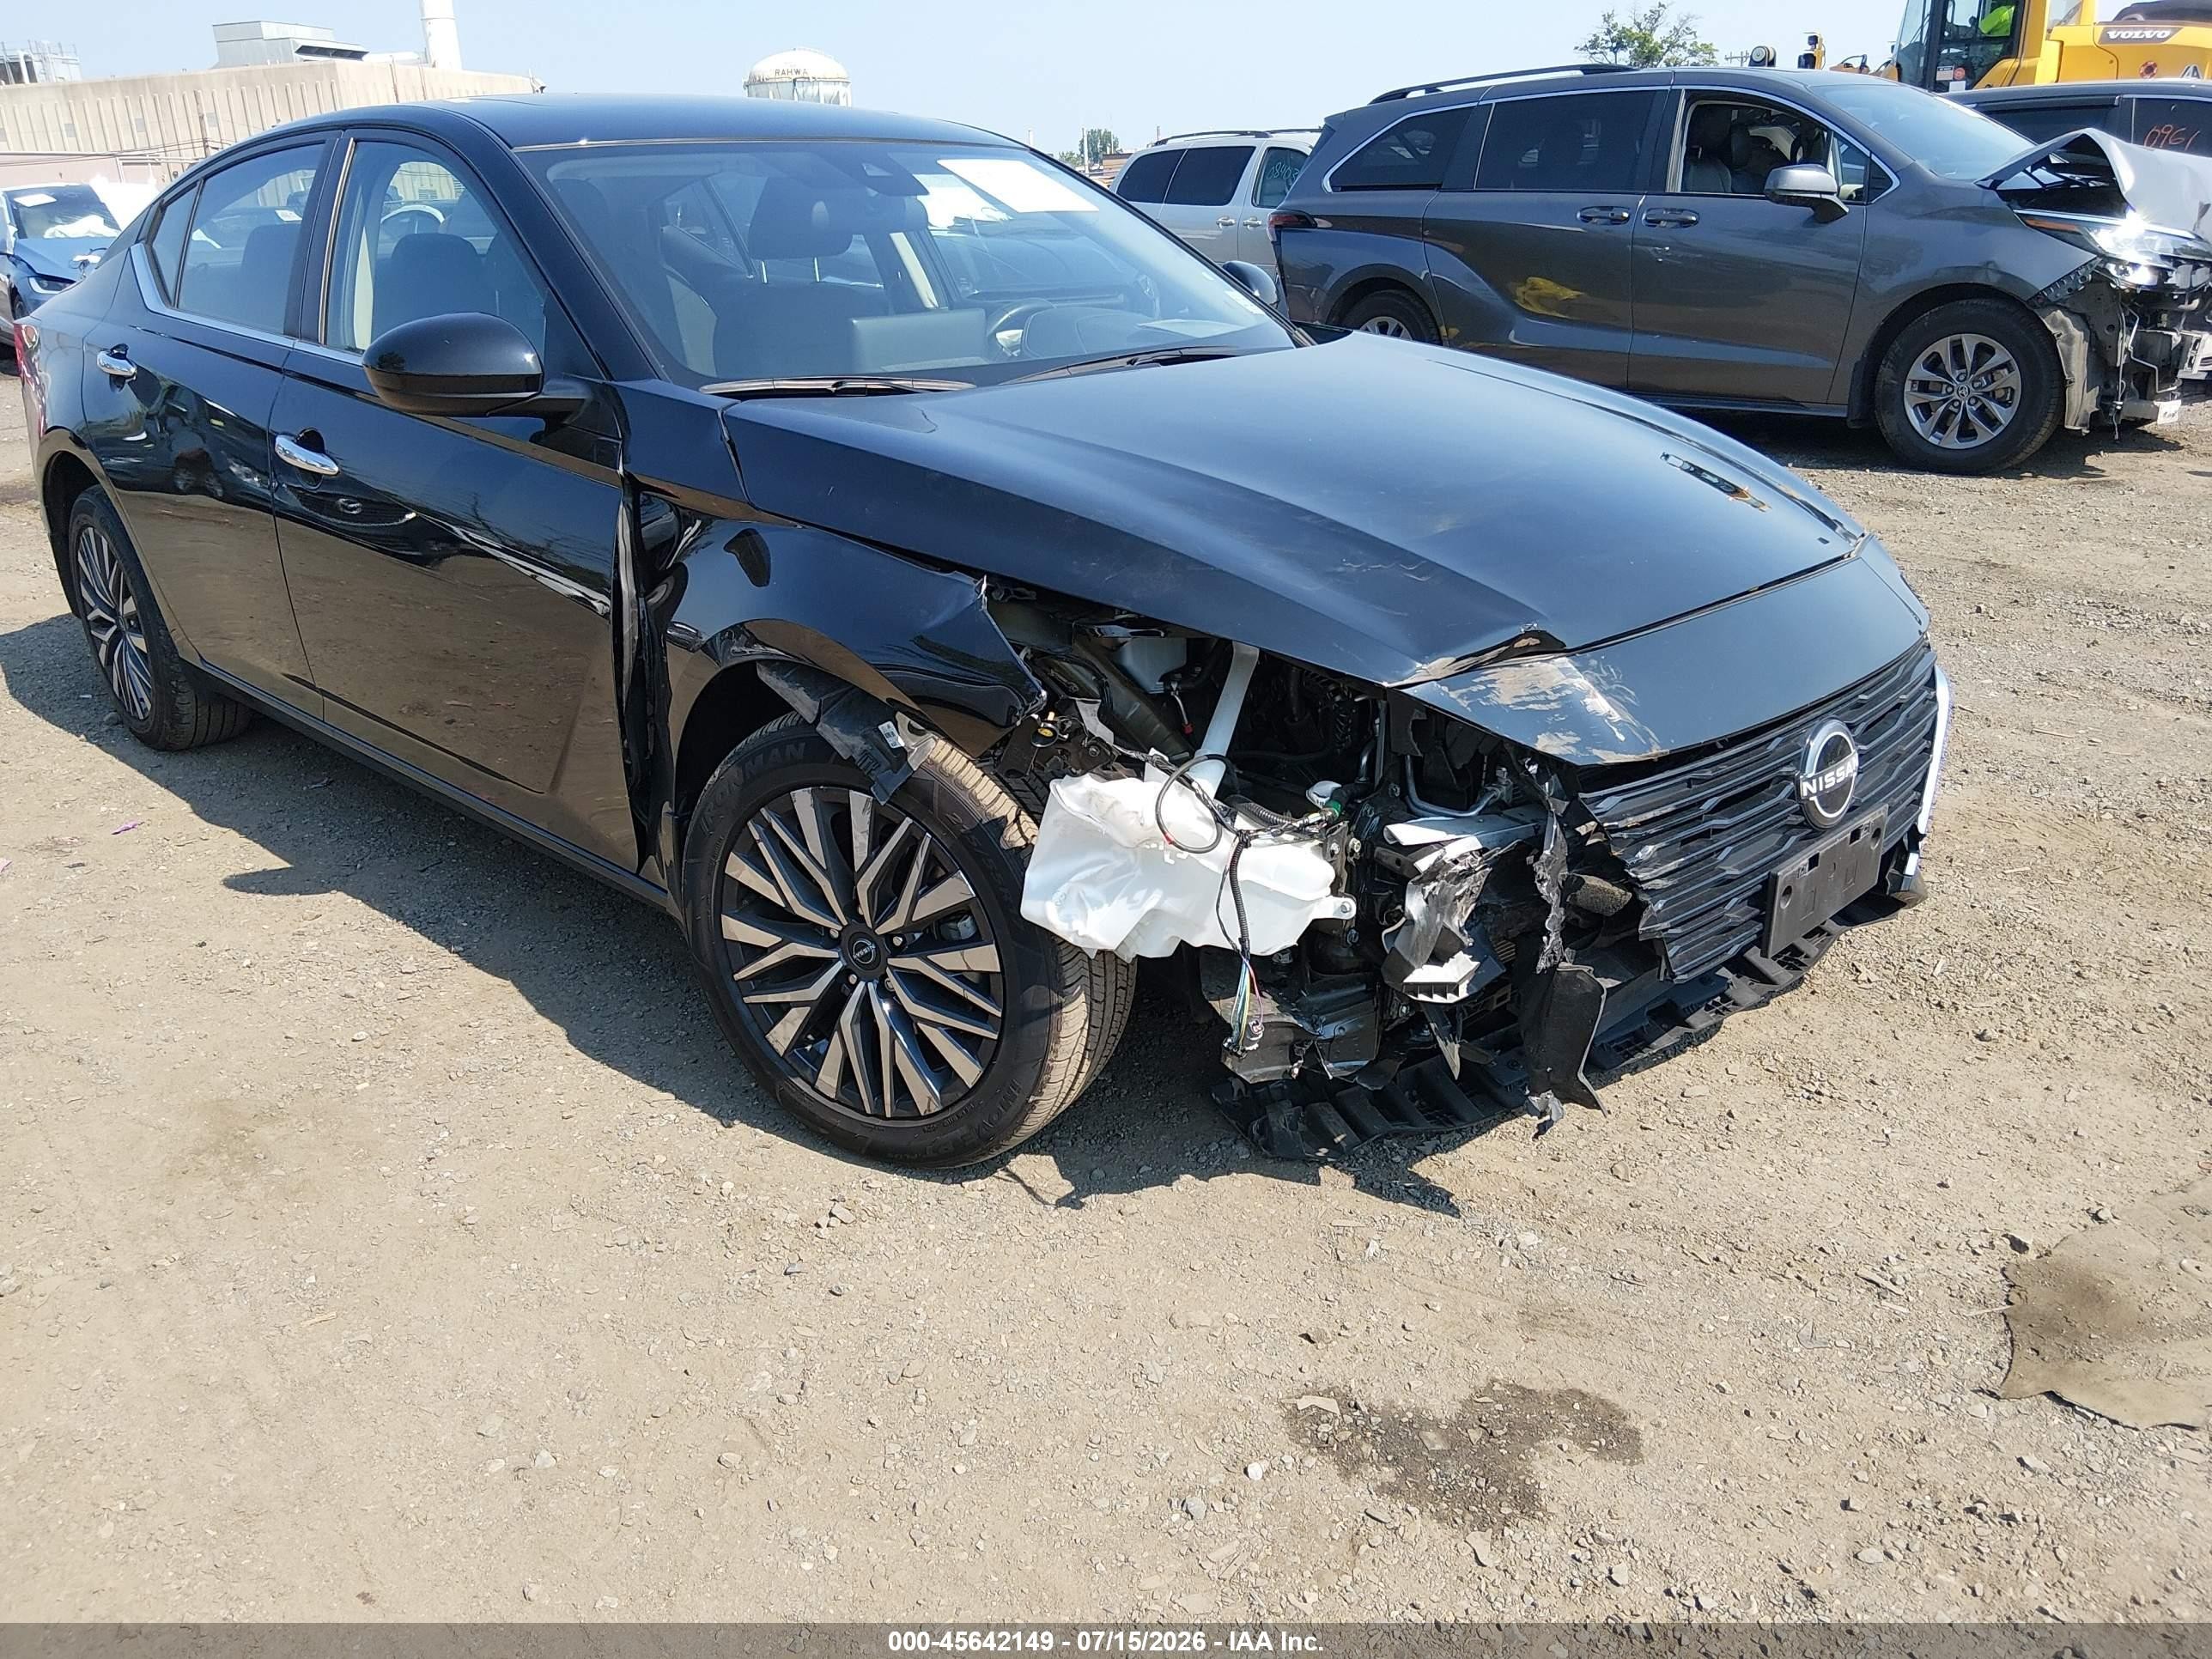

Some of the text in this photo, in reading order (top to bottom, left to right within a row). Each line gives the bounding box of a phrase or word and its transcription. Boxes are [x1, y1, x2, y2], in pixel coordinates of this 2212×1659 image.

[2106, 30, 2172, 40] VOLVO
[700, 741, 806, 839] IRONMAN
[1802, 759, 1858, 798] NISSAN
